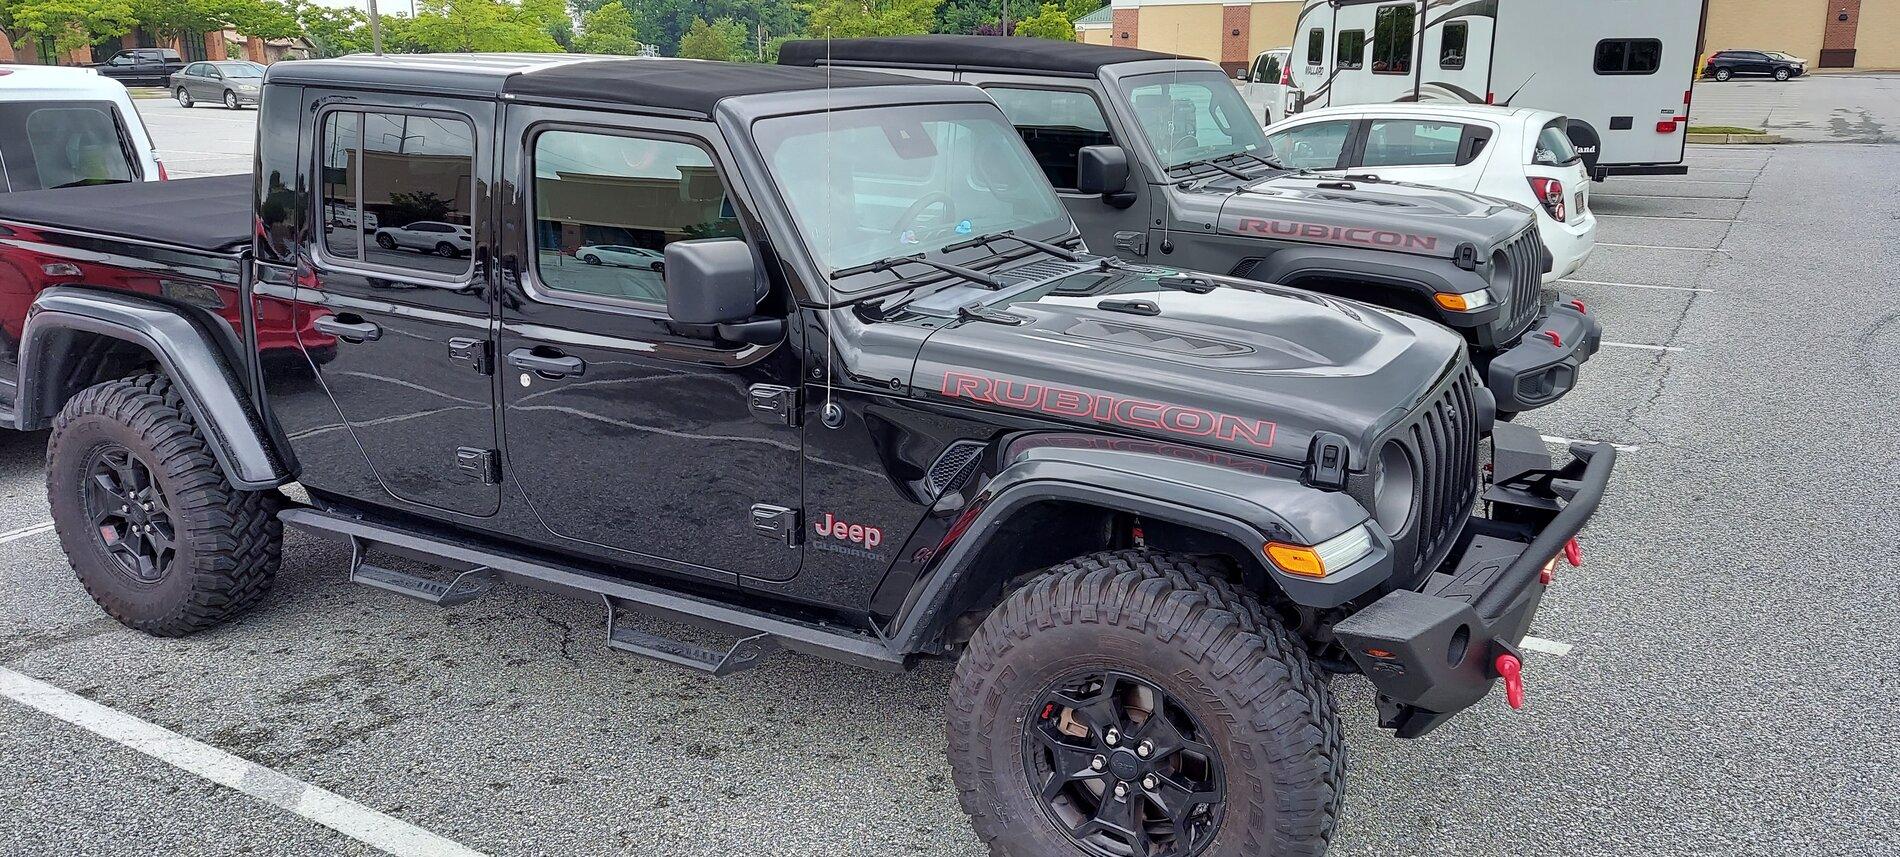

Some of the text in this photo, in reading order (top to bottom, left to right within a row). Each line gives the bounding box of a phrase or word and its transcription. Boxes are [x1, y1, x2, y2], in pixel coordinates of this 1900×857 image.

[1238, 217, 1437, 250] RUBICON
[941, 371, 1276, 448] RUBICON
[815, 512, 883, 549] Jeep
[812, 540, 886, 563] GLADIATOR
